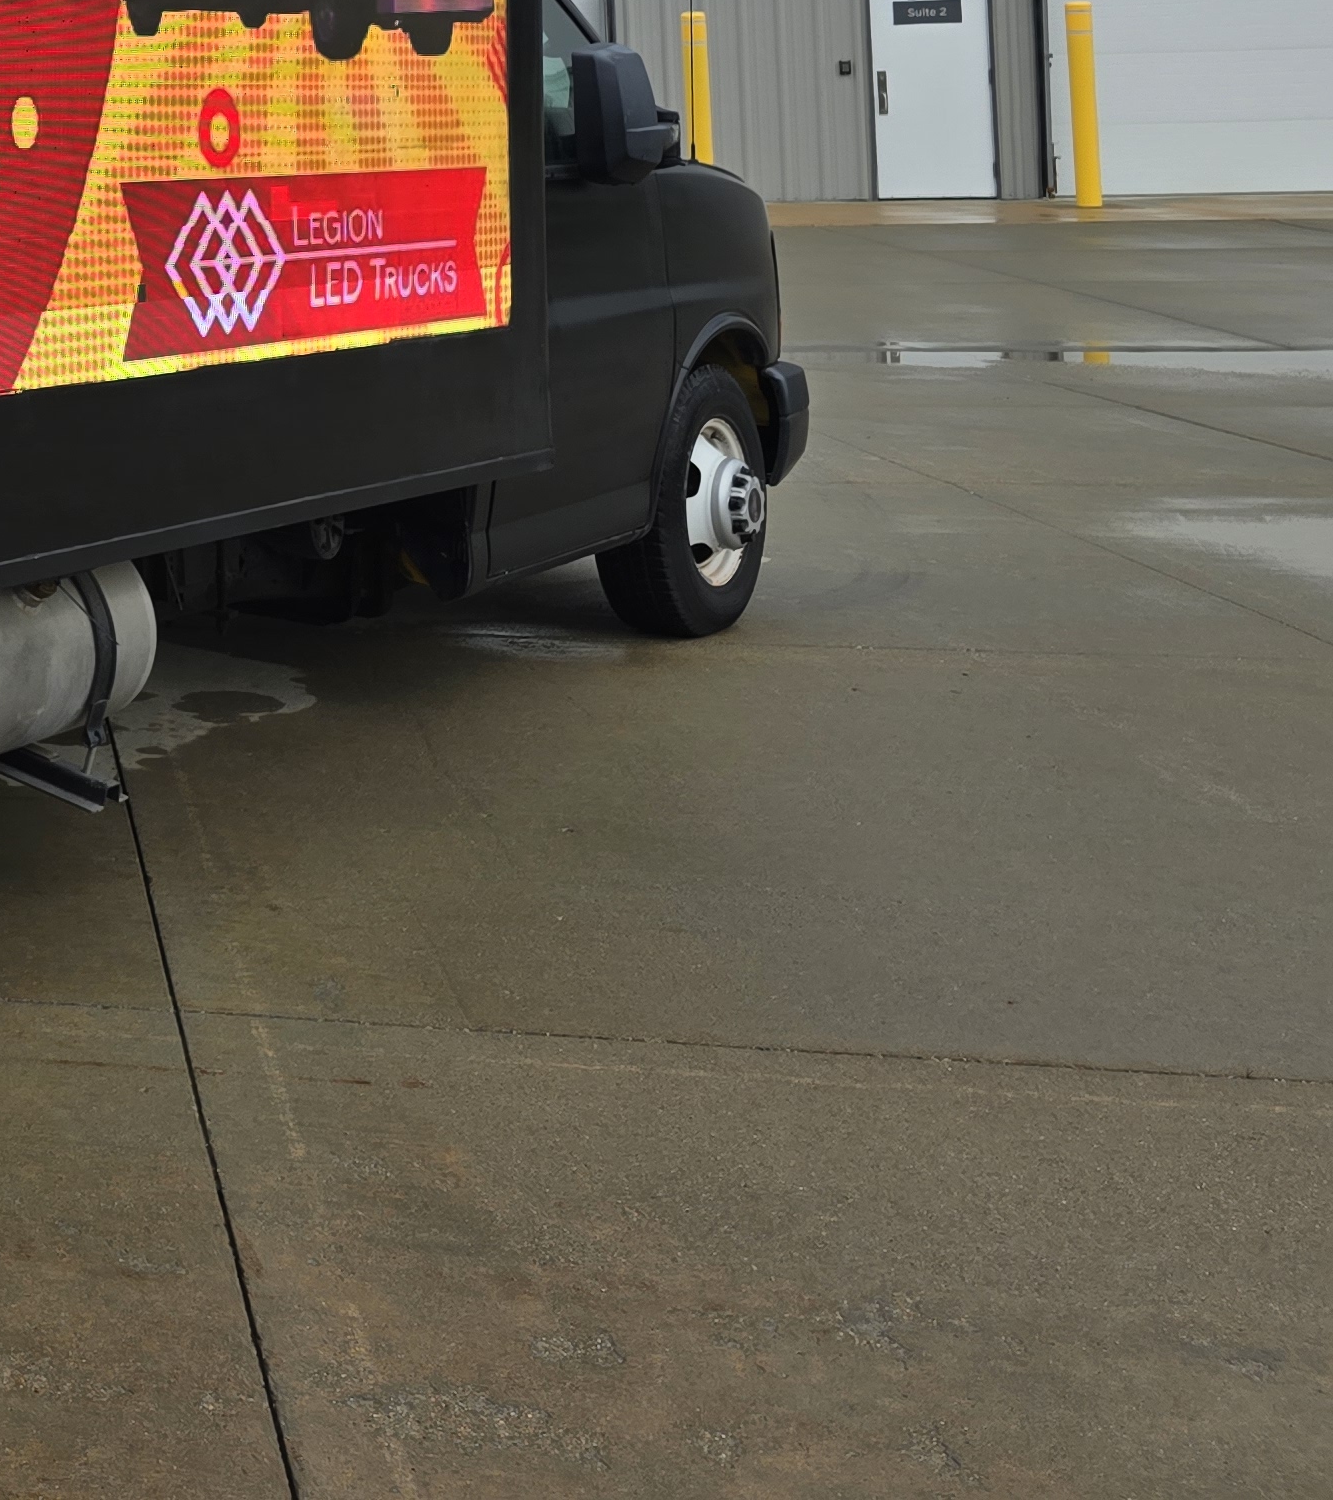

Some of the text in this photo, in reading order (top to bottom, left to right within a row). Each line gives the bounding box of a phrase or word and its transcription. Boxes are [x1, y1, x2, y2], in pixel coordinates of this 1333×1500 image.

[906, 7, 947, 18] Suite 2
[309, 261, 363, 308] LED
